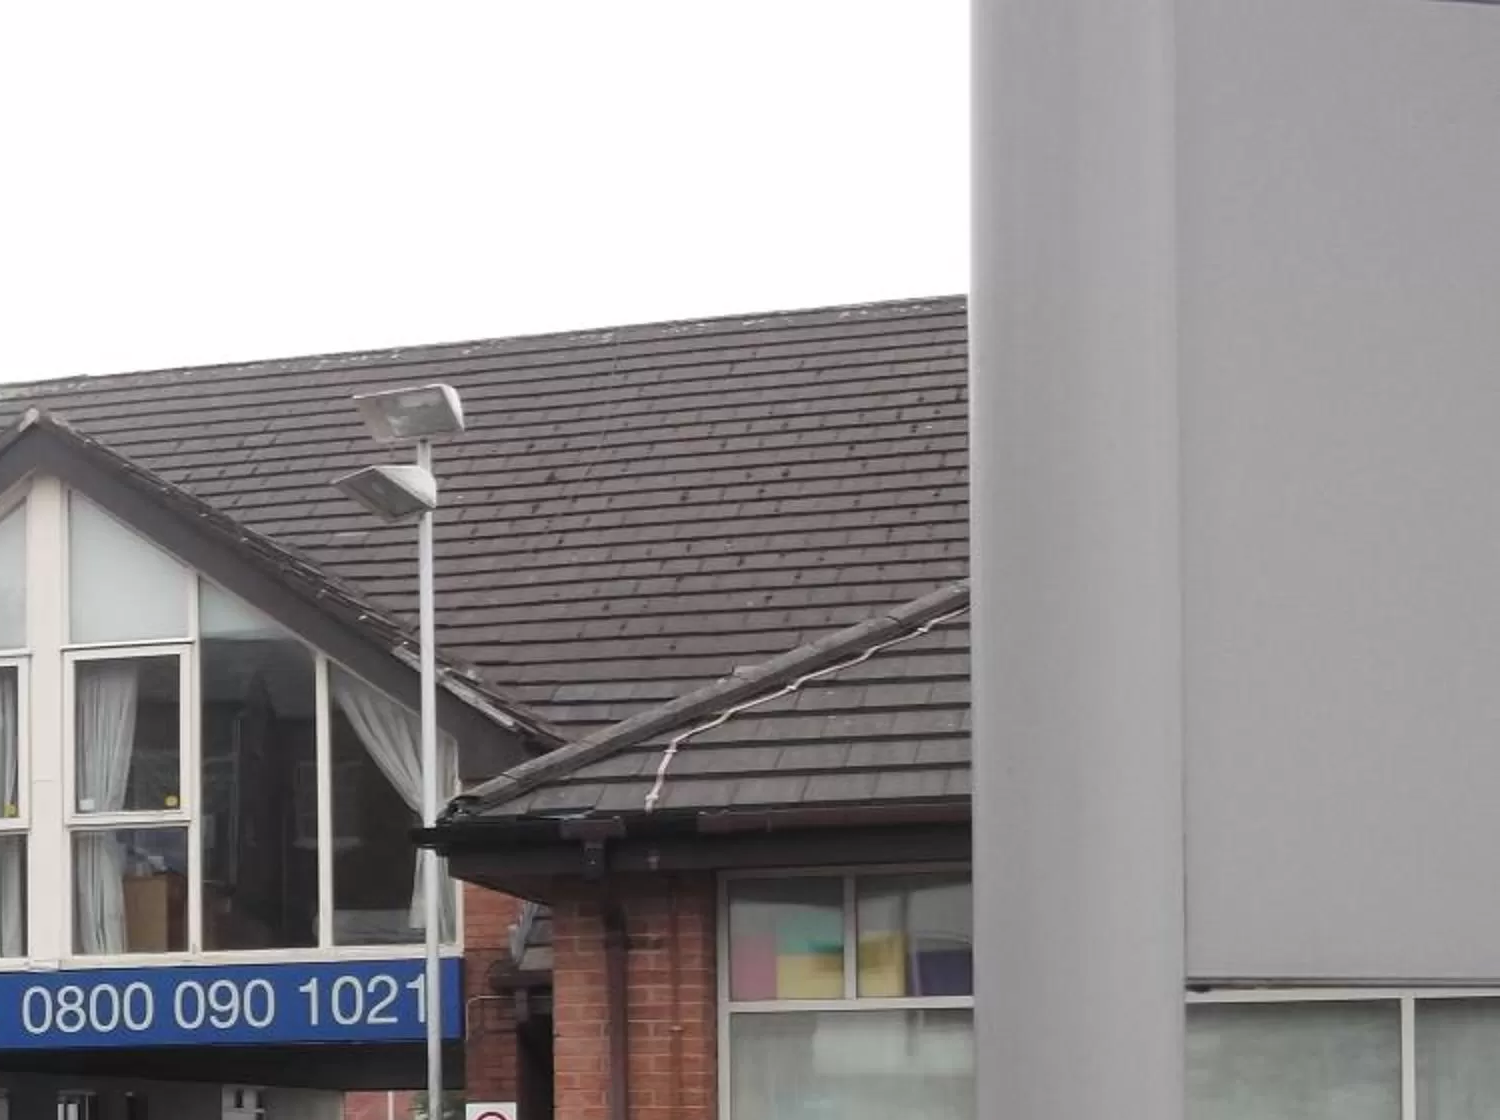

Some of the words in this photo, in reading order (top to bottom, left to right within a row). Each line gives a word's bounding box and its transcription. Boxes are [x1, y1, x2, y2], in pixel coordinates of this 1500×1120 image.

[22, 982, 154, 1034] 0800
[173, 979, 275, 1029] 090
[299, 973, 426, 1025] 1021
